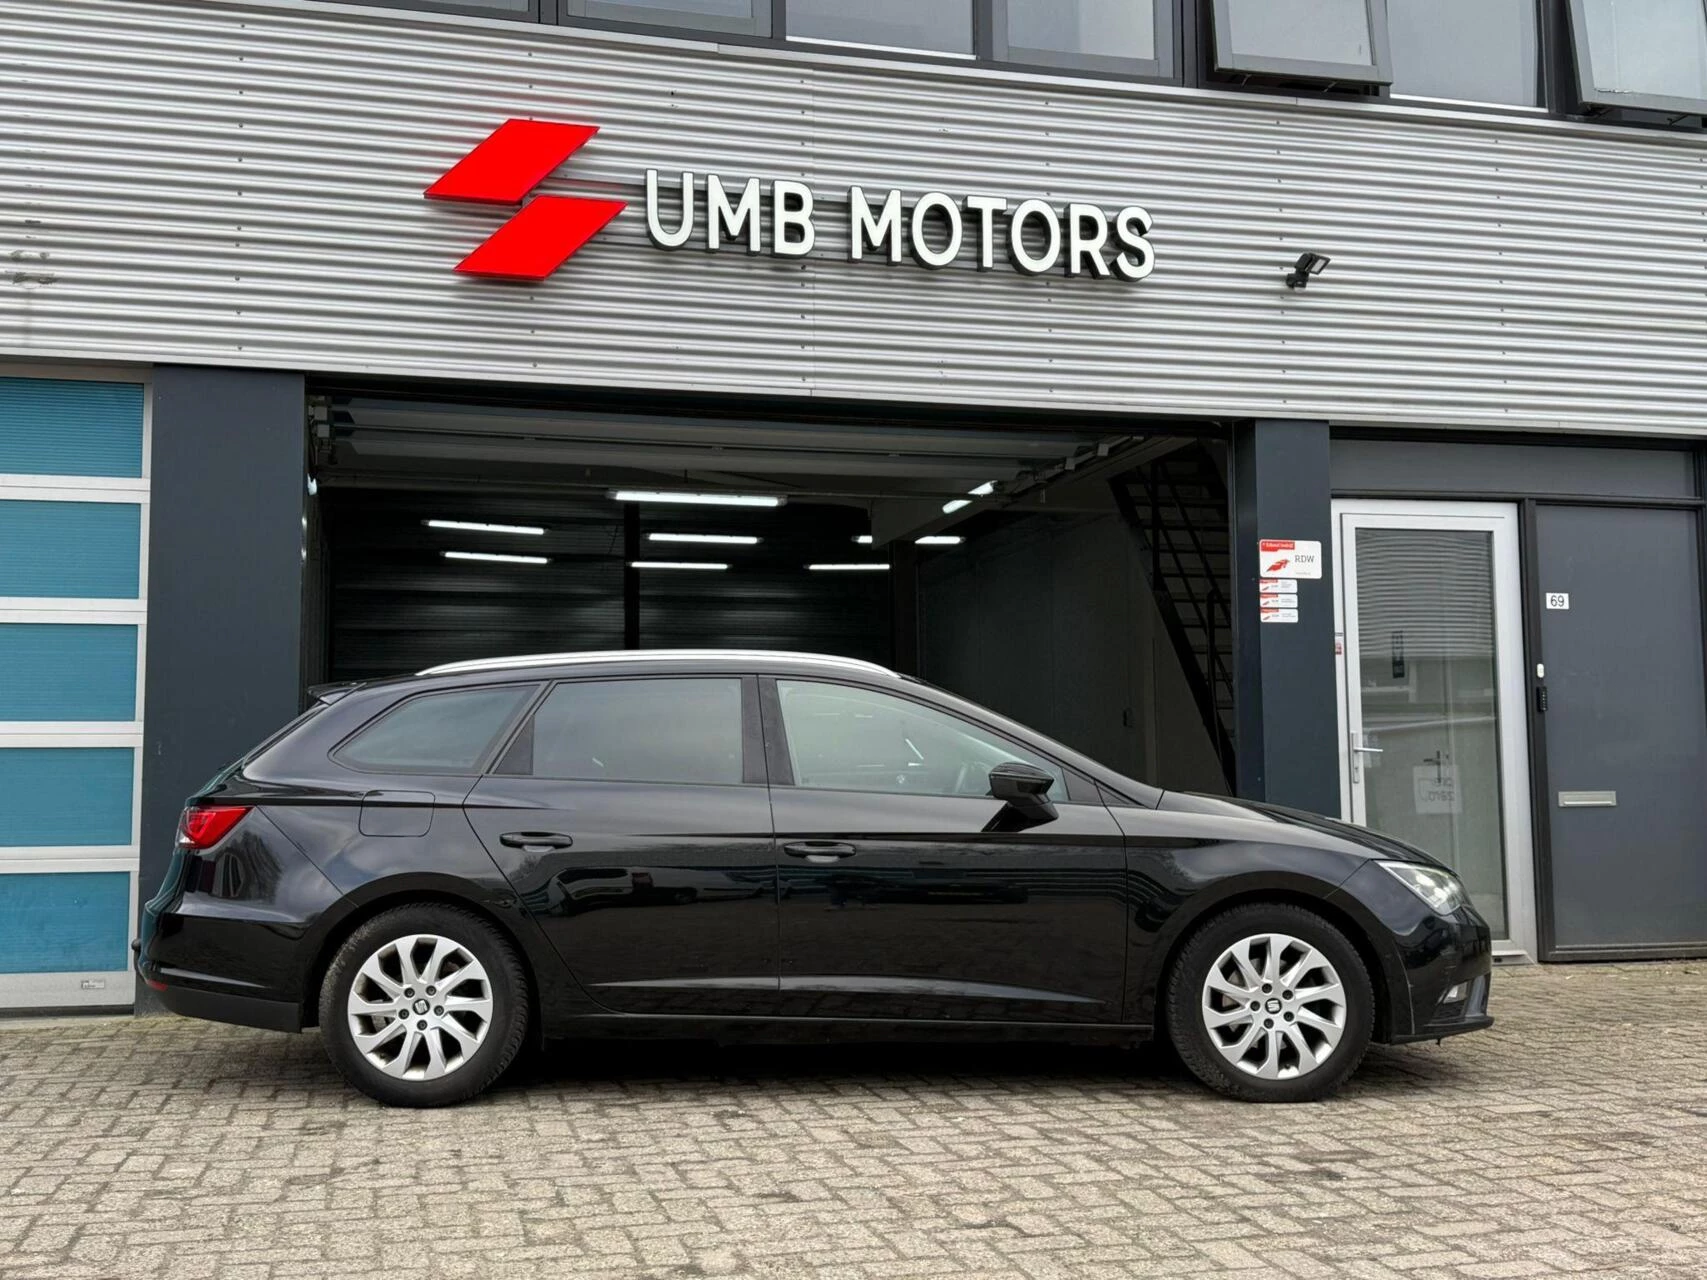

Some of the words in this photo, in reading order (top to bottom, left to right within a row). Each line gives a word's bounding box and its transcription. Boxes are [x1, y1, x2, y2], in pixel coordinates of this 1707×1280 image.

[645, 168, 816, 258] UMB
[849, 185, 1157, 283] MOTORS
[1294, 555, 1315, 563] RDW
[1550, 594, 1565, 608] 69
